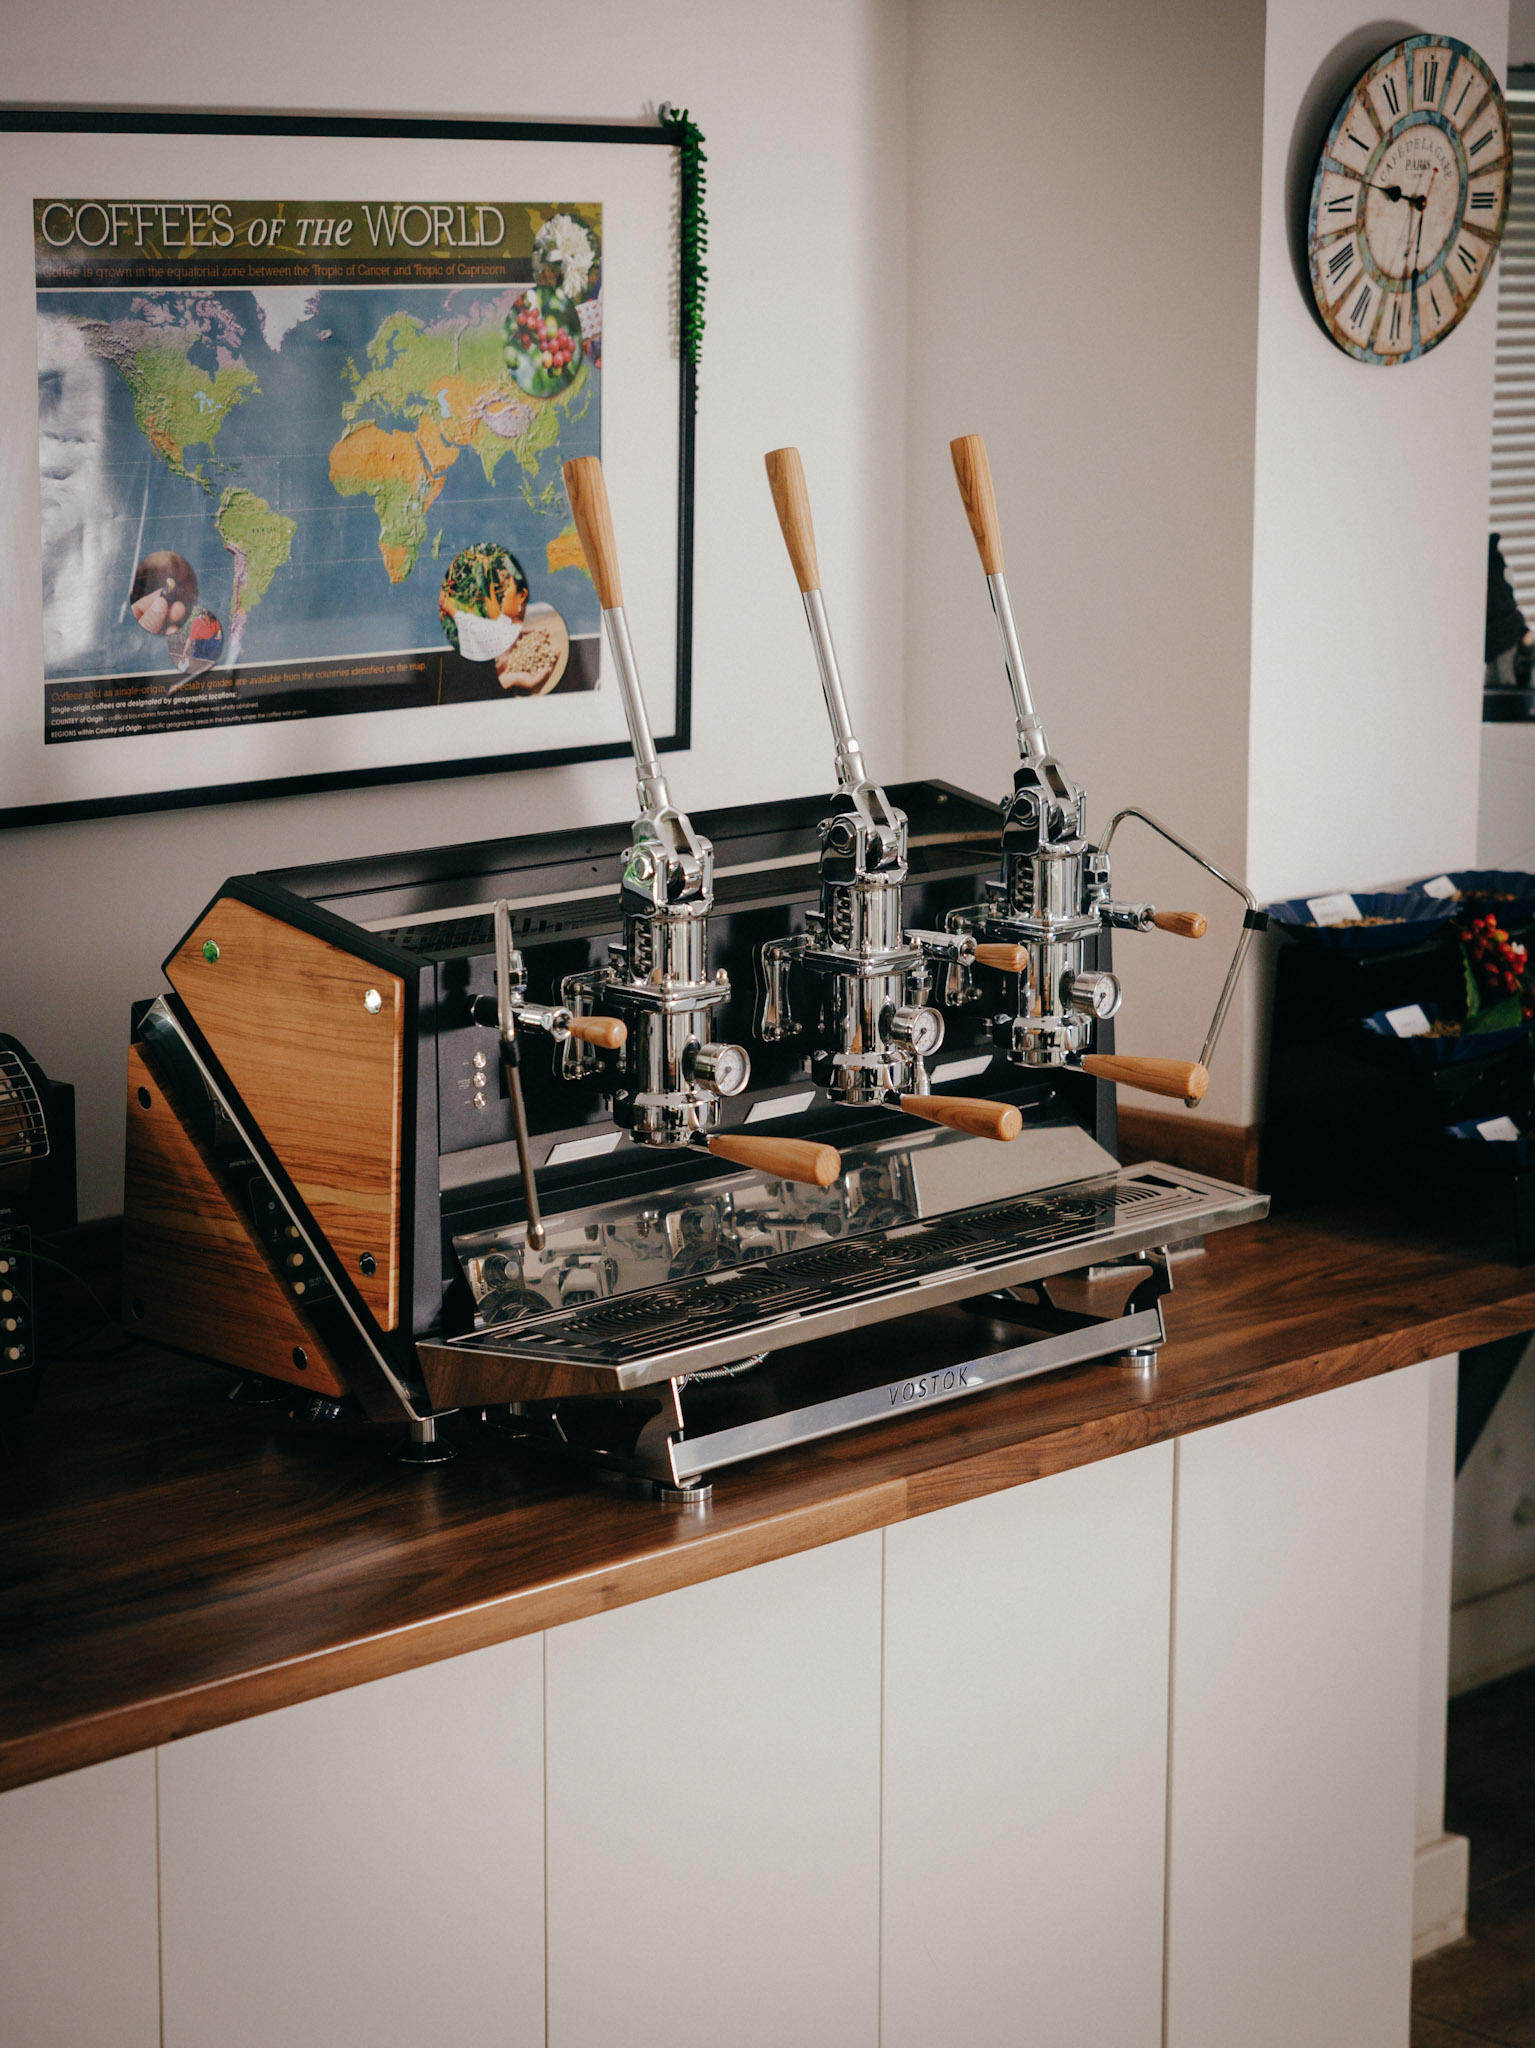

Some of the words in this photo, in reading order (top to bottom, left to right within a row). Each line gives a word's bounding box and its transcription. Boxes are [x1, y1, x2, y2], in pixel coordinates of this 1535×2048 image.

[41, 202, 235, 247] COFFEES
[247, 218, 286, 247] OF
[361, 205, 505, 247] WORLD
[42, 264, 80, 279] Coffee
[83, 264, 93, 278] is
[96, 266, 132, 280] grown
[135, 266, 146, 277] in
[148, 265, 164, 277] the
[167, 265, 219, 280] equatorial
[222, 267, 246, 277] zone
[249, 264, 291, 277] between
[294, 264, 310, 276] the
[312, 263, 343, 278] Tropic
[346, 263, 356, 276] of
[357, 264, 391, 276] Cancer
[393, 264, 411, 276] and
[413, 263, 443, 278] Tropic
[445, 263, 456, 276] of
[51, 690, 83, 702] Coffees
[85, 688, 102, 699] sold
[104, 689, 113, 698] as
[207, 678, 233, 690] grades
[235, 677, 247, 686] are
[249, 672, 282, 685] available
[284, 671, 301, 682] from
[302, 670, 314, 680] the
[315, 668, 350, 679] countries
[351, 664, 385, 676] identified
[386, 664, 396, 673] on
[396, 662, 408, 672] the
[50, 703, 91, 715] Single-origin
[91, 700, 114, 711] coffees
[116, 701, 126, 709] are
[127, 698, 163, 709] designated
[163, 696, 172, 706] by
[172, 694, 208, 706] geographic
[50, 718, 79, 726] COUNTRY
[79, 716, 86, 724] of
[86, 715, 104, 725] Origin
[50, 729, 77, 739] REGIONS
[77, 728, 94, 736] within
[95, 726, 118, 735] Country
[124, 724, 142, 734] Origin
[888, 1366, 968, 1405] VOSTOK
